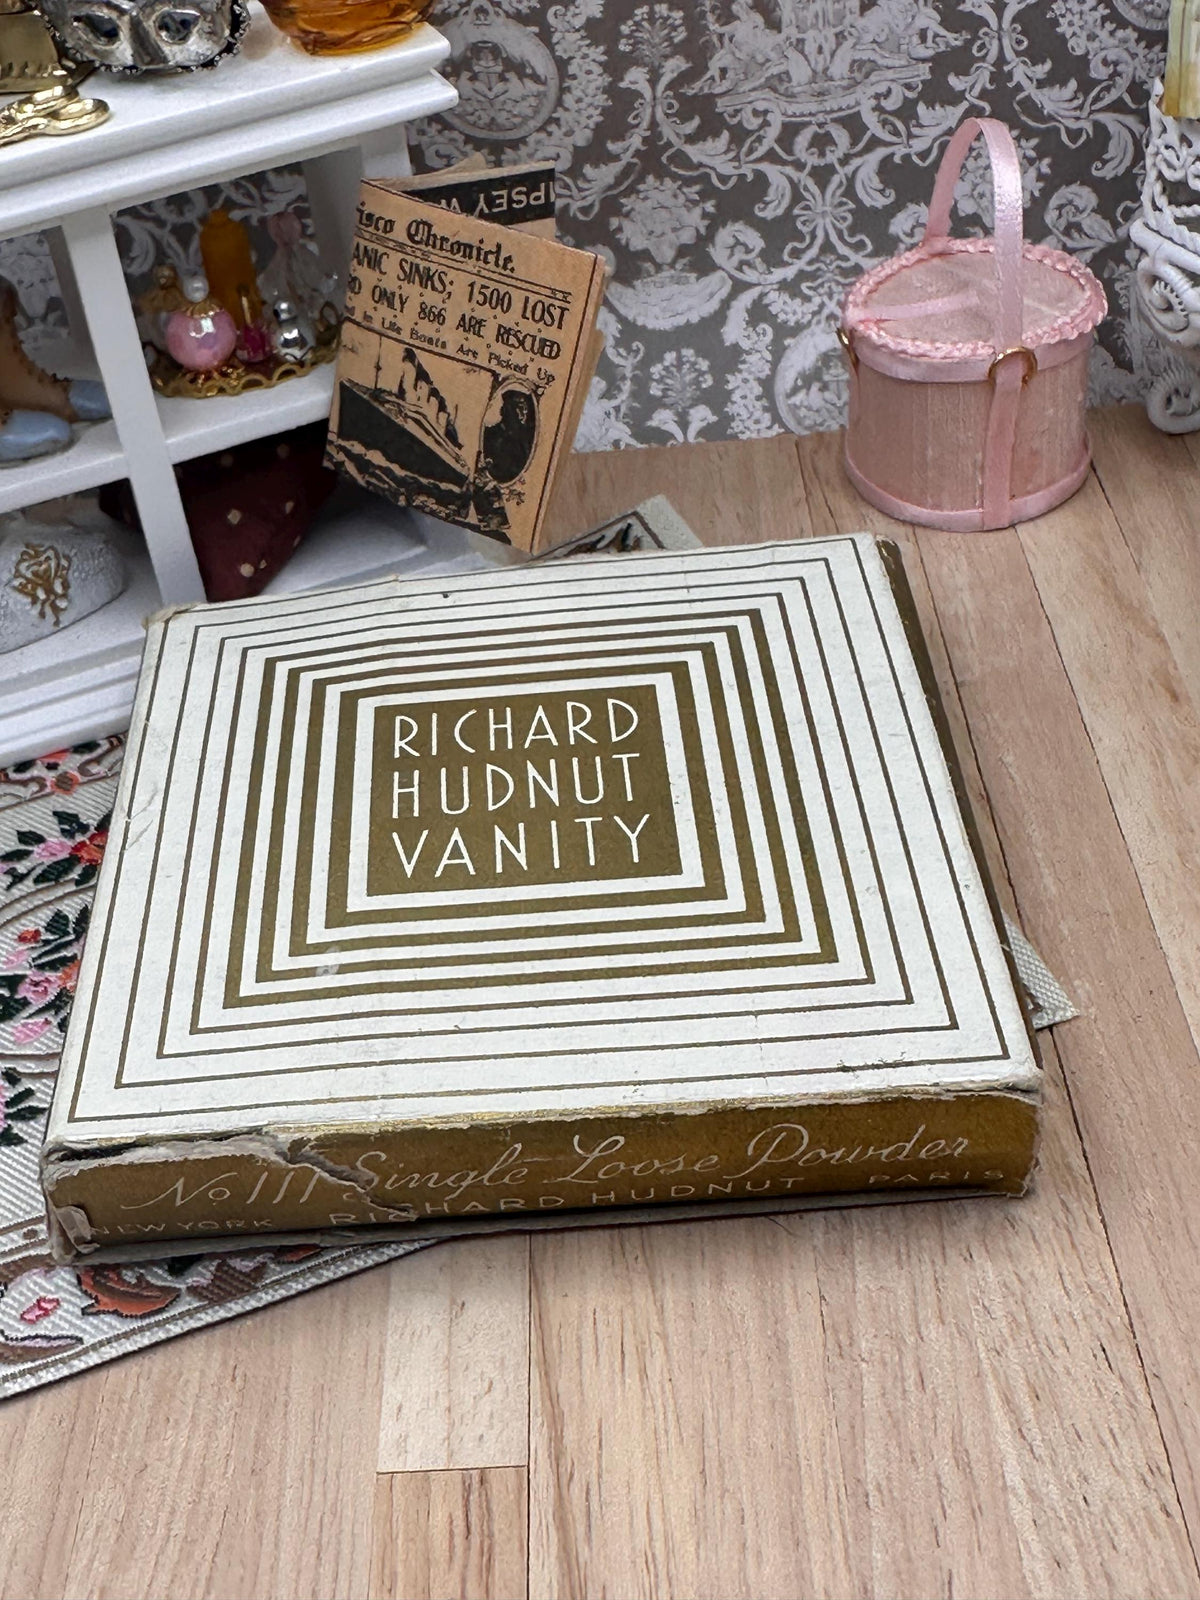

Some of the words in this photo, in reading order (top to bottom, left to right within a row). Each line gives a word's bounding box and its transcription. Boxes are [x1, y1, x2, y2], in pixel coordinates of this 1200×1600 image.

[372, 285, 410, 314] ONLY
[418, 301, 447, 326] 866
[456, 313, 488, 339] ARE
[495, 323, 562, 360] RESCUED
[397, 258, 454, 299] SINKS;
[467, 281, 513, 314] 1500
[521, 296, 570, 330] LOST
[488, 352, 529, 375] Picked
[537, 367, 556, 386] Up
[394, 698, 639, 759] RICHARD
[392, 753, 641, 819] HUDNUT
[392, 813, 650, 878] VANITY
[343, 1142, 532, 1200] Single
[542, 1134, 721, 1185] Loose
[723, 1123, 969, 1179] Powder
[177, 1218, 273, 1232] YORK
[328, 1194, 565, 1226] RICHARD
[592, 1177, 805, 1205] HUDNUT
[868, 1170, 1005, 1185] PARIS
